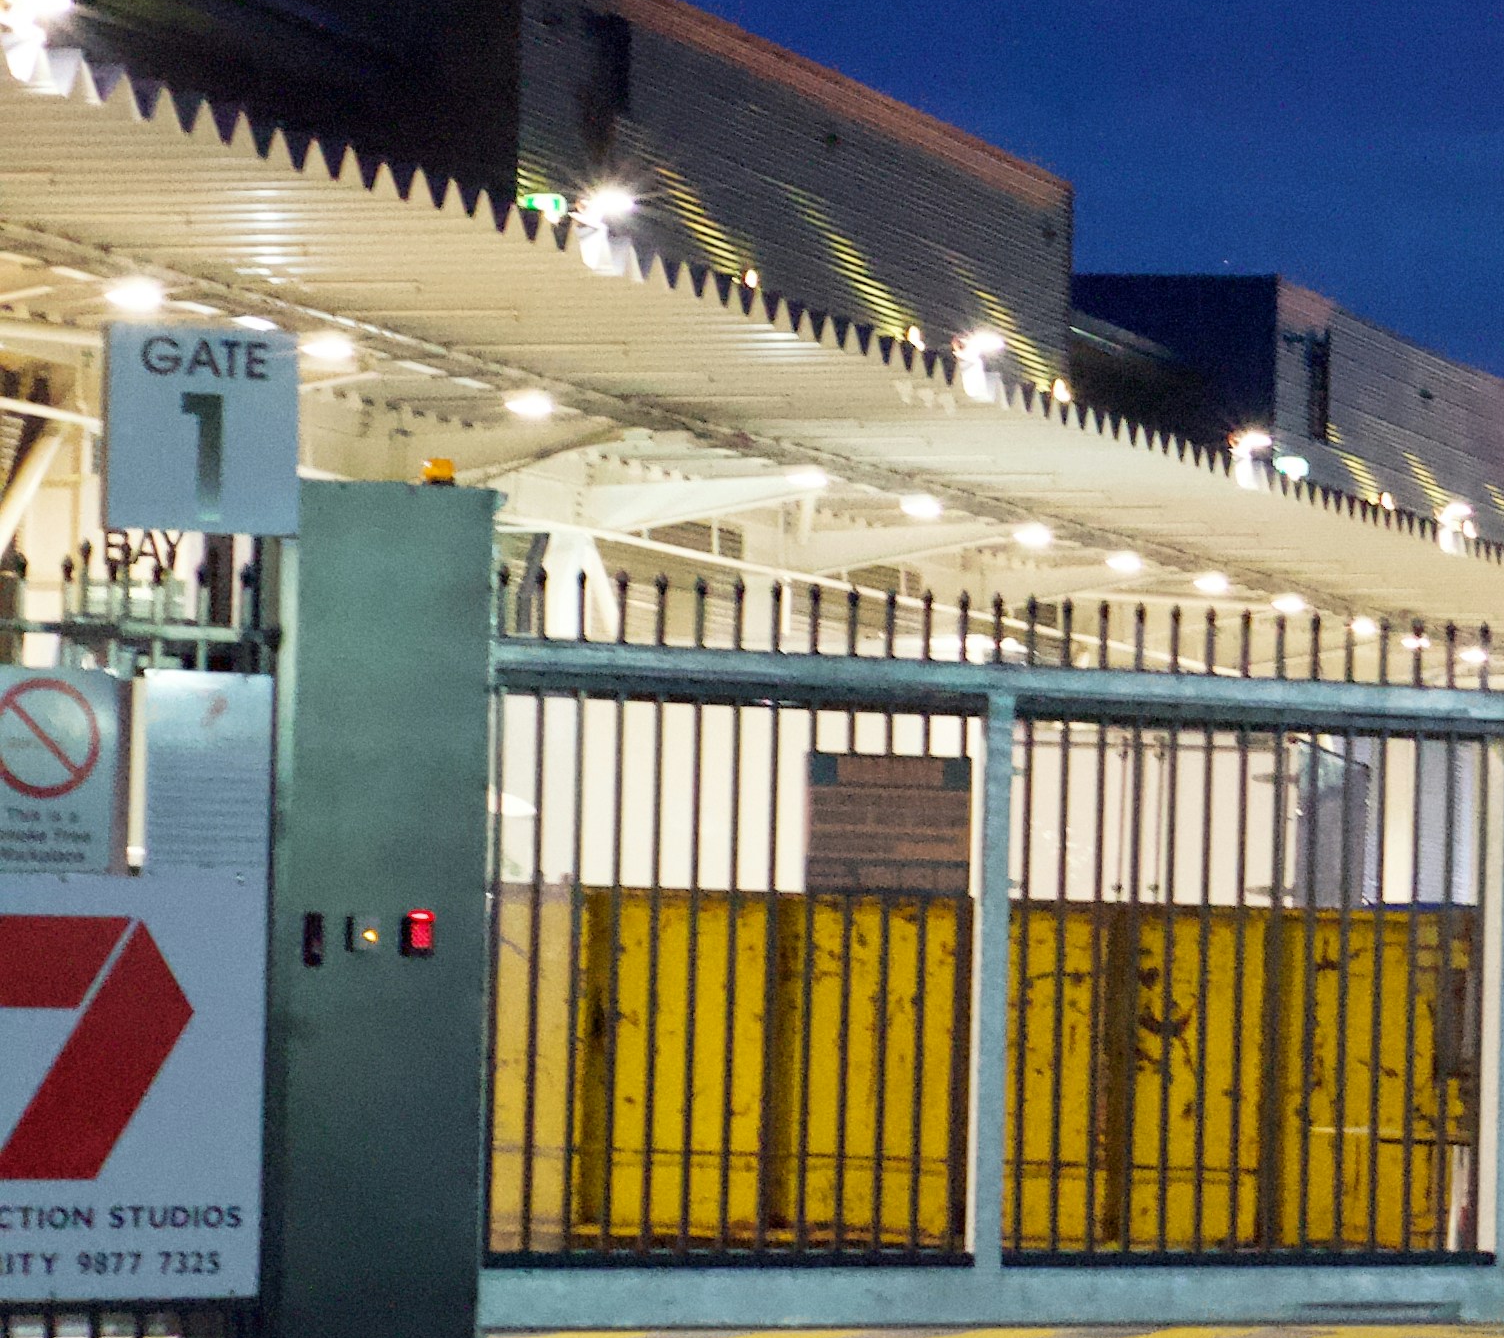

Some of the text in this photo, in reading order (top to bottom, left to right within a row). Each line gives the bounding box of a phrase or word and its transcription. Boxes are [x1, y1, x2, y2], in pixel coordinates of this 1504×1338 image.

[140, 335, 271, 381] GATE
[180, 391, 224, 522] 1
[108, 1204, 243, 1230] STUDIOS
[76, 1251, 142, 1276] 9877
[158, 1250, 221, 1275] 7325
